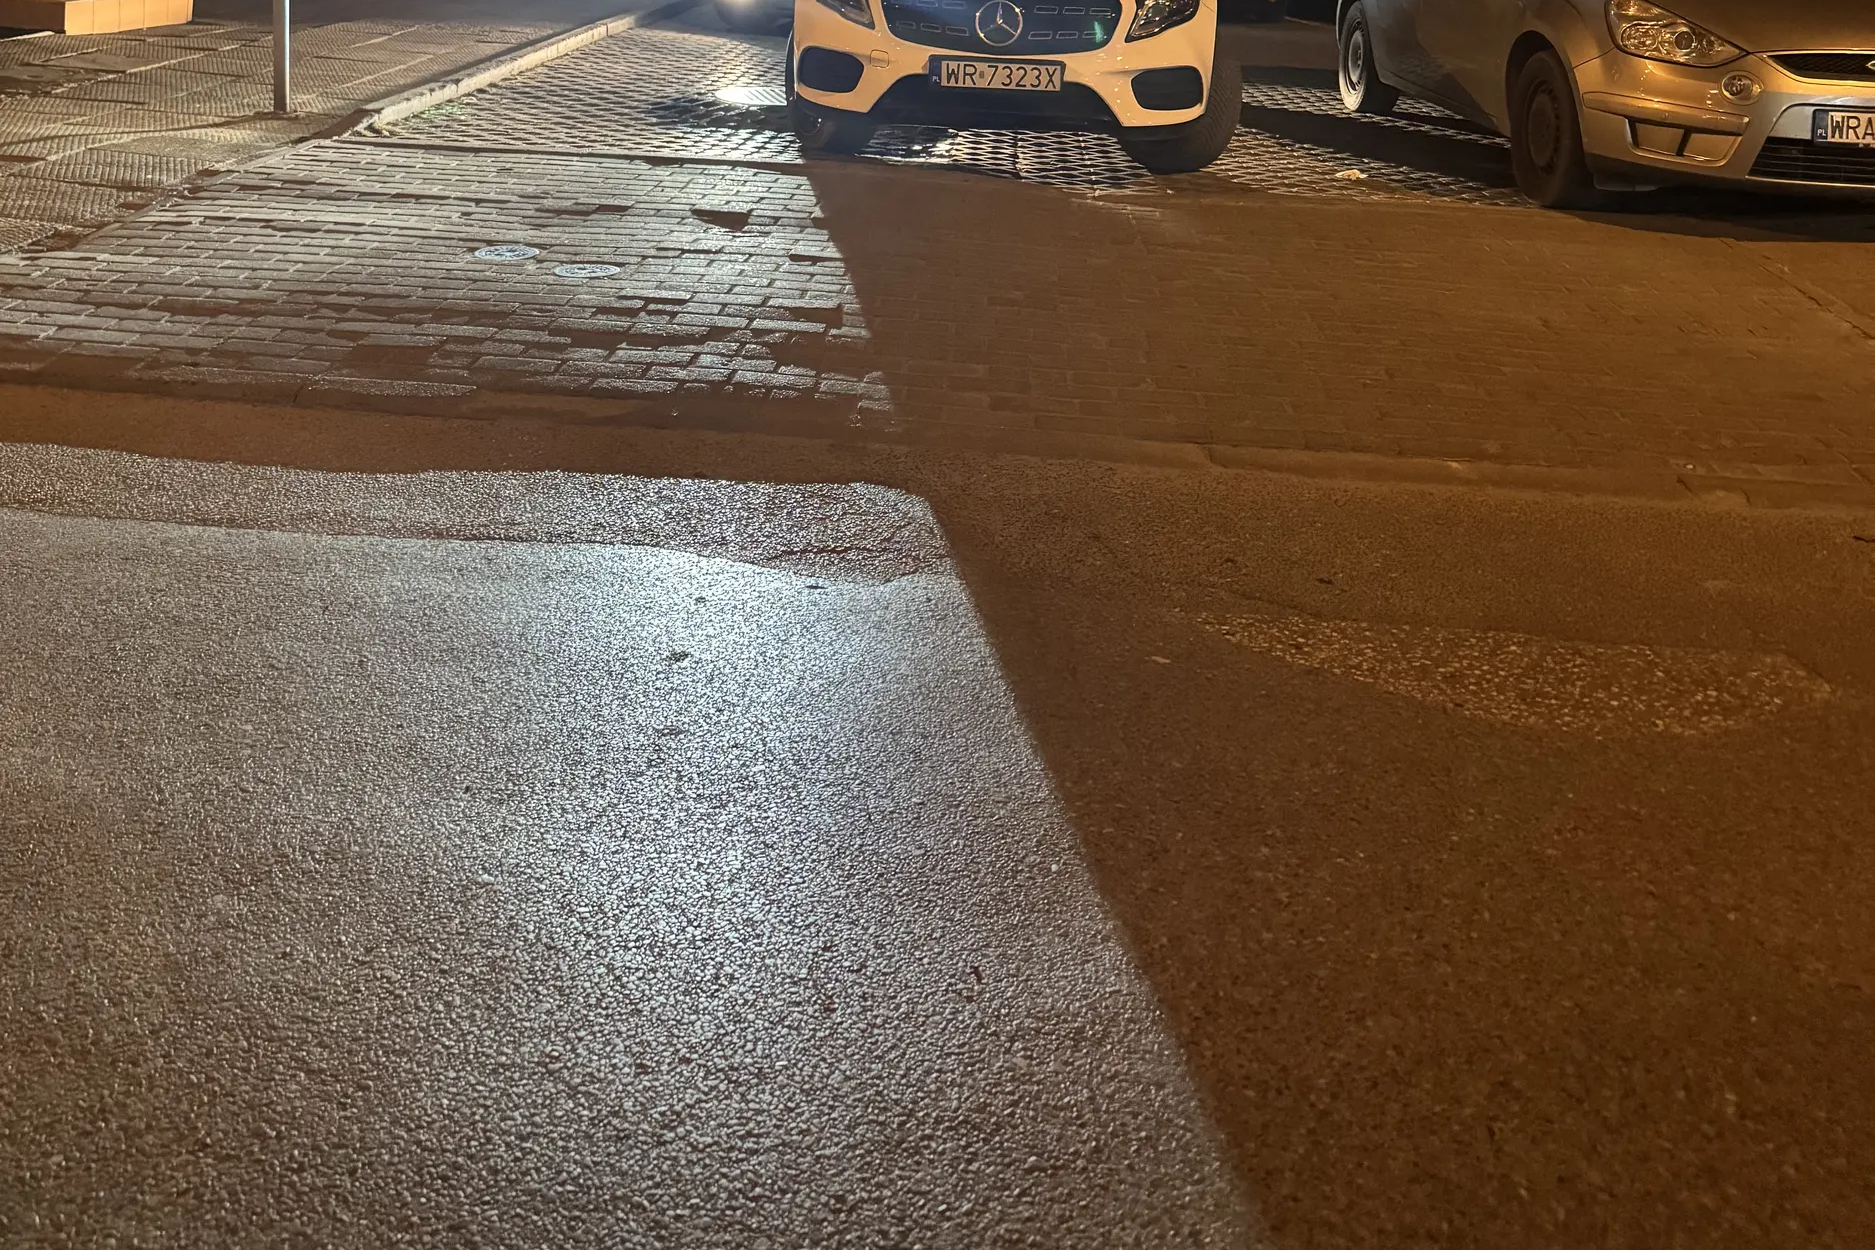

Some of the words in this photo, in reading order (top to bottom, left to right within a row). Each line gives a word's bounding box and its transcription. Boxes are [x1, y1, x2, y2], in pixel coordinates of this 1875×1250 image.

[932, 75, 940, 83] PL
[946, 63, 978, 86] WR
[986, 64, 1058, 90] 7323X
[1830, 114, 1875, 140] WRA
